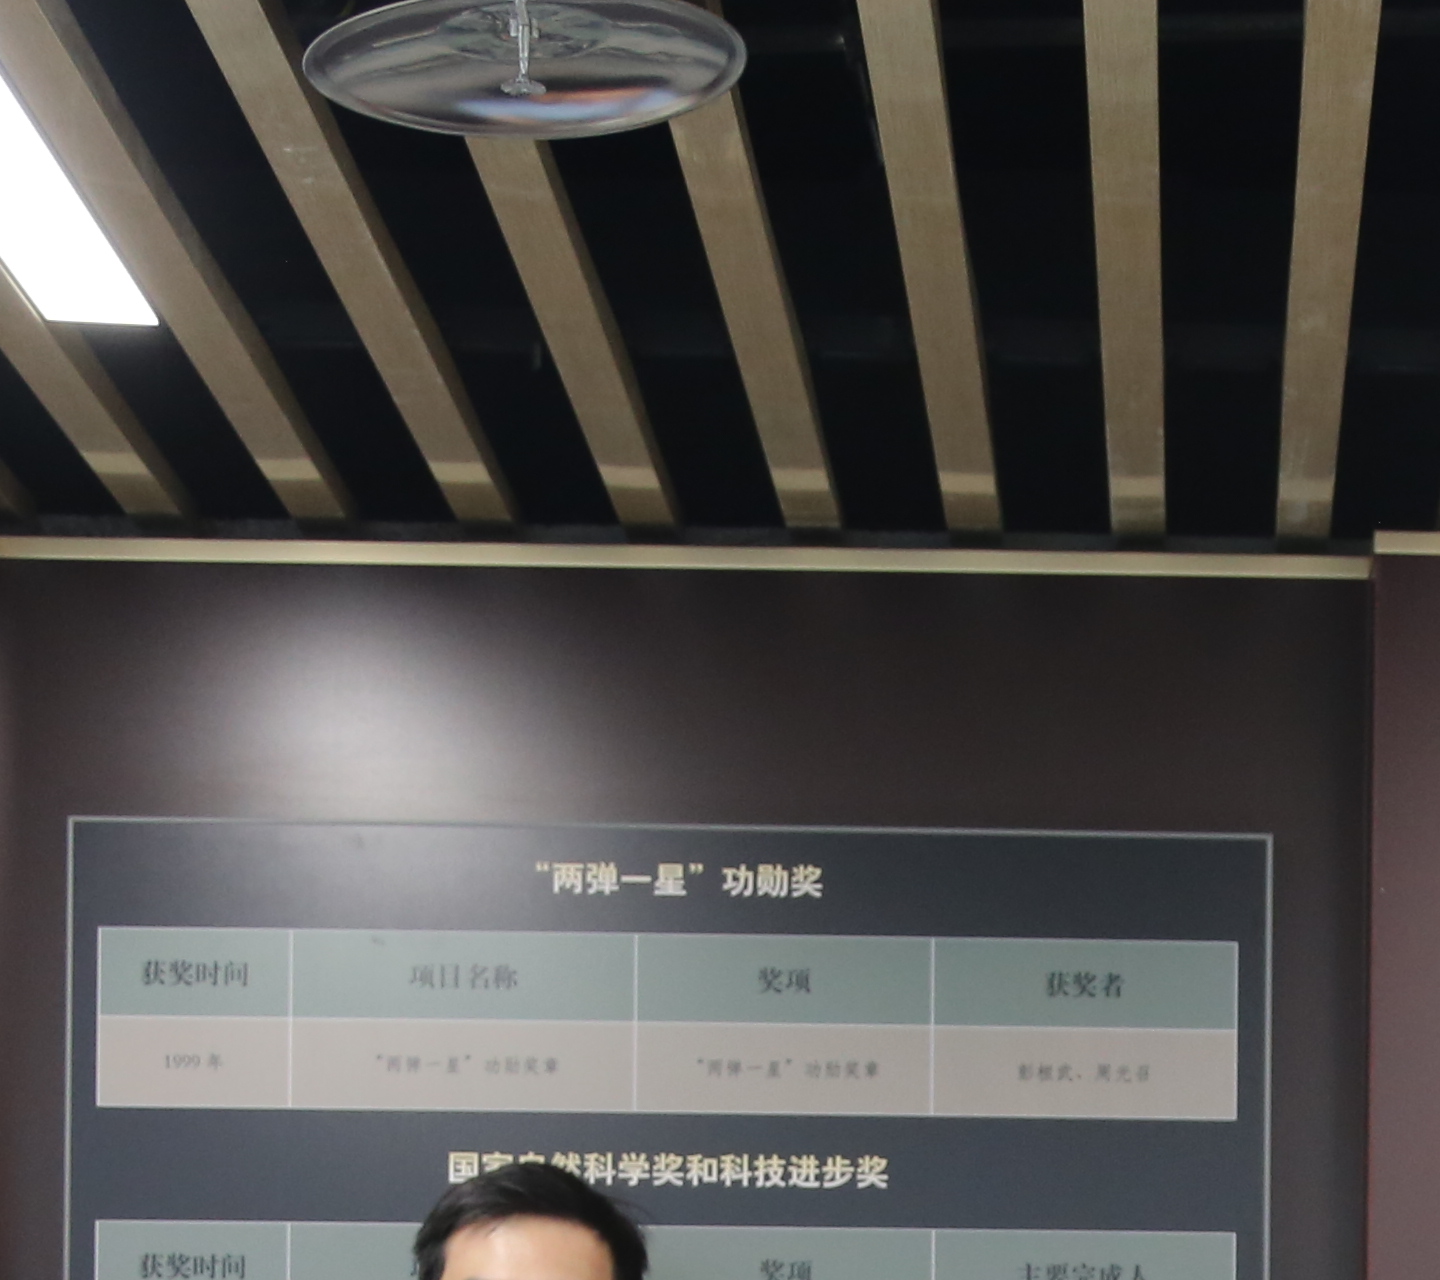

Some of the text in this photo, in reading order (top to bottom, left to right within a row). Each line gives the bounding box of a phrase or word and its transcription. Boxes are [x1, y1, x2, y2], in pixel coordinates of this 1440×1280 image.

[140, 958, 251, 988] 获奖时间
[409, 963, 519, 991] 项目名称
[759, 967, 812, 994] 奖项
[1044, 970, 1126, 999] 获奖者
[140, 1252, 247, 1280] 获奖时间
